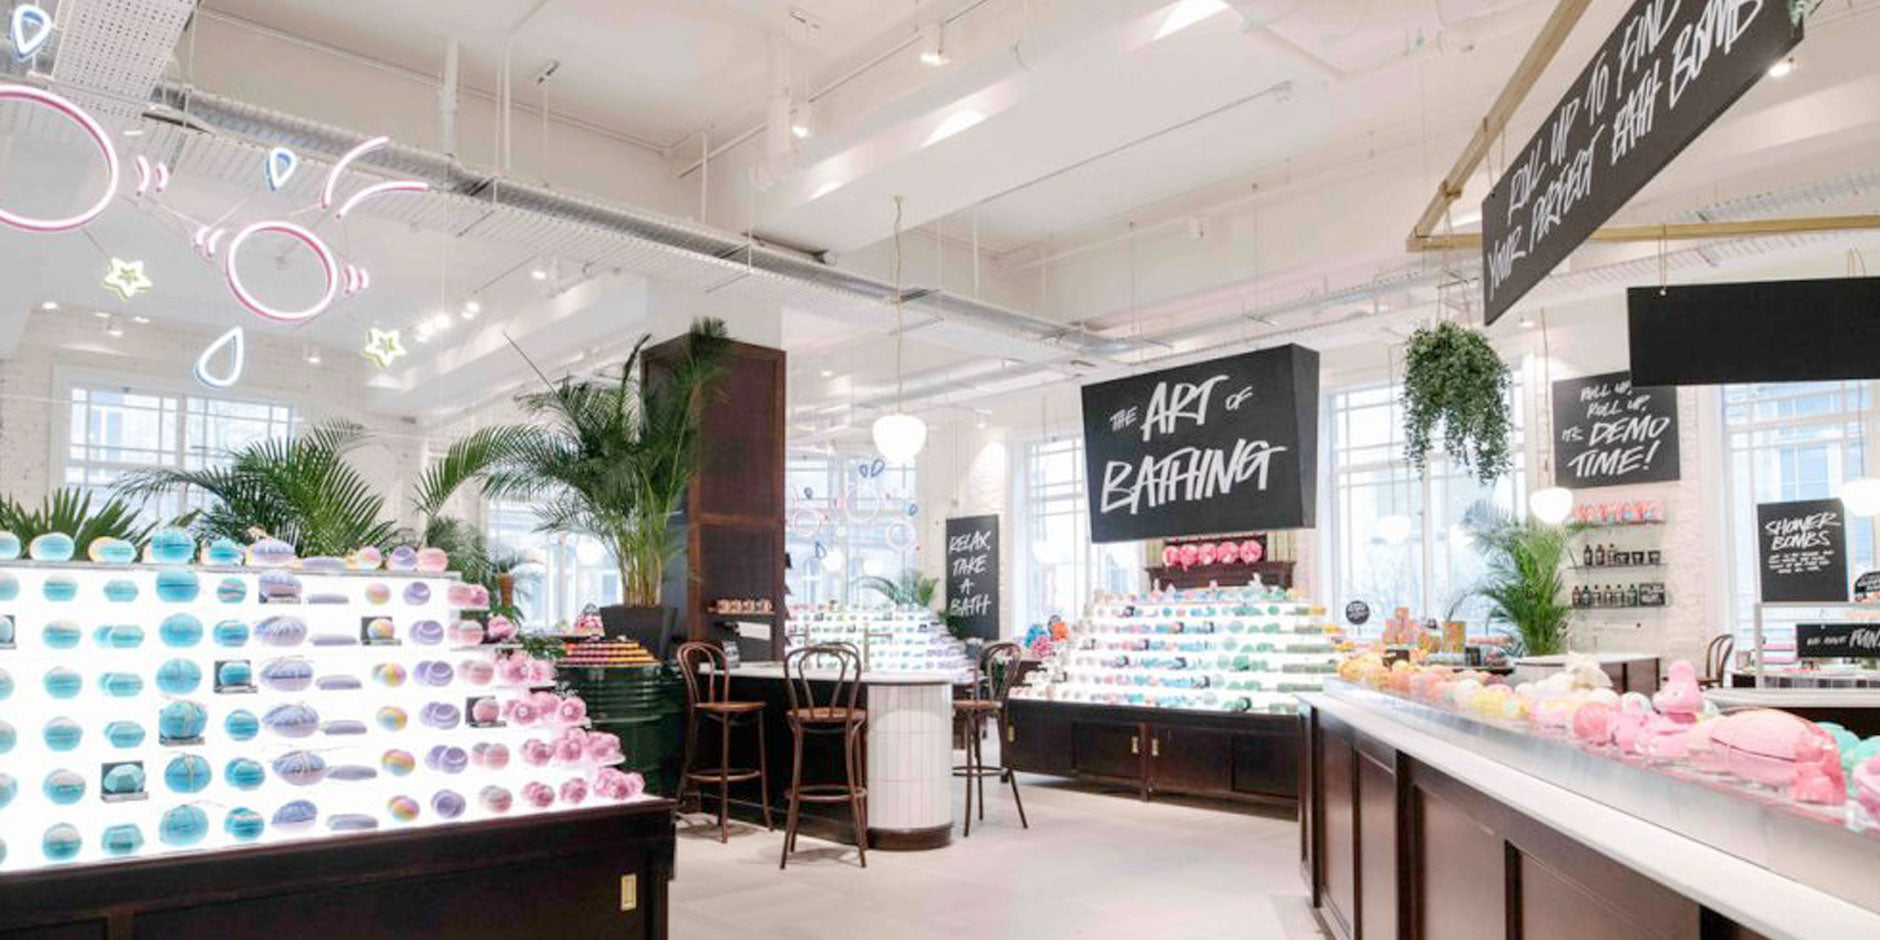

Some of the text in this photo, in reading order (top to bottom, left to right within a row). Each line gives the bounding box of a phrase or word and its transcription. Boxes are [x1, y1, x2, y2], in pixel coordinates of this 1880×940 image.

[1507, 0, 1683, 225] ROLL UP TO FIND
[1487, 225, 1527, 301] YOUR
[1529, 123, 1605, 253] PERFECT
[1611, 58, 1663, 165] BATH
[1580, 382, 1612, 403] ROLL
[1109, 374, 1254, 442] THE ART OF
[1586, 399, 1624, 420] ROLL
[1588, 414, 1671, 447] DEMO
[1566, 439, 1662, 478] TIME!
[1100, 438, 1289, 515] BATHING
[1764, 511, 1842, 536] SHOWER
[1770, 530, 1832, 551] BOMBS
[952, 553, 988, 577] TAKE
[959, 577, 976, 595] A
[949, 593, 992, 617] BATH
